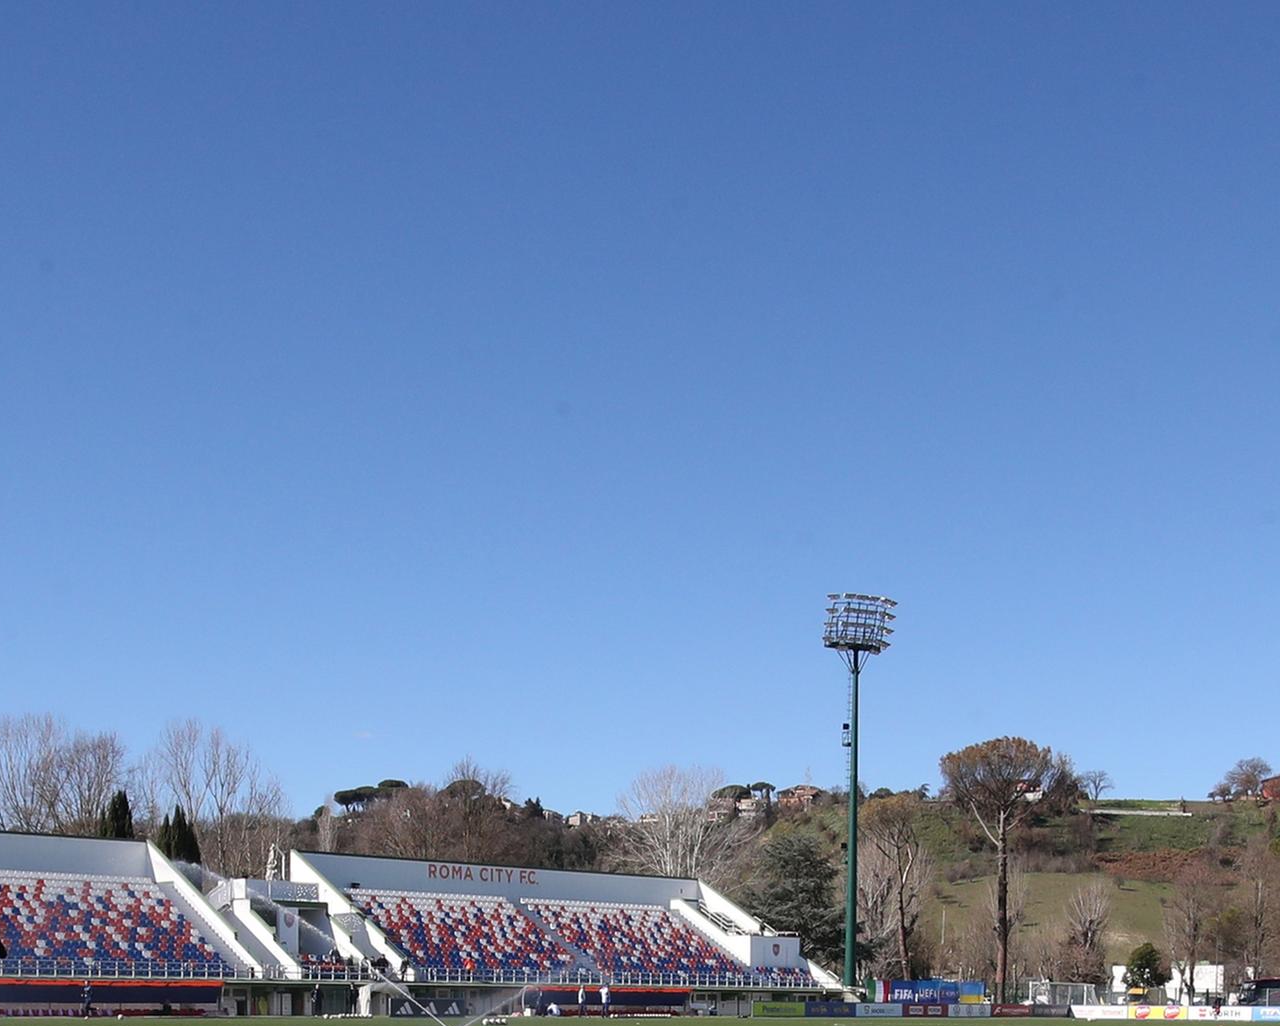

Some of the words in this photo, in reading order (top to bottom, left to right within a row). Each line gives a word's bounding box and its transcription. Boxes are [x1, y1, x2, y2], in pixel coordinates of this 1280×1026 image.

[428, 864, 473, 880] ROMA
[480, 868, 513, 883] CITY
[520, 870, 539, 885] F.C.
[894, 989, 913, 1000] FIFA
